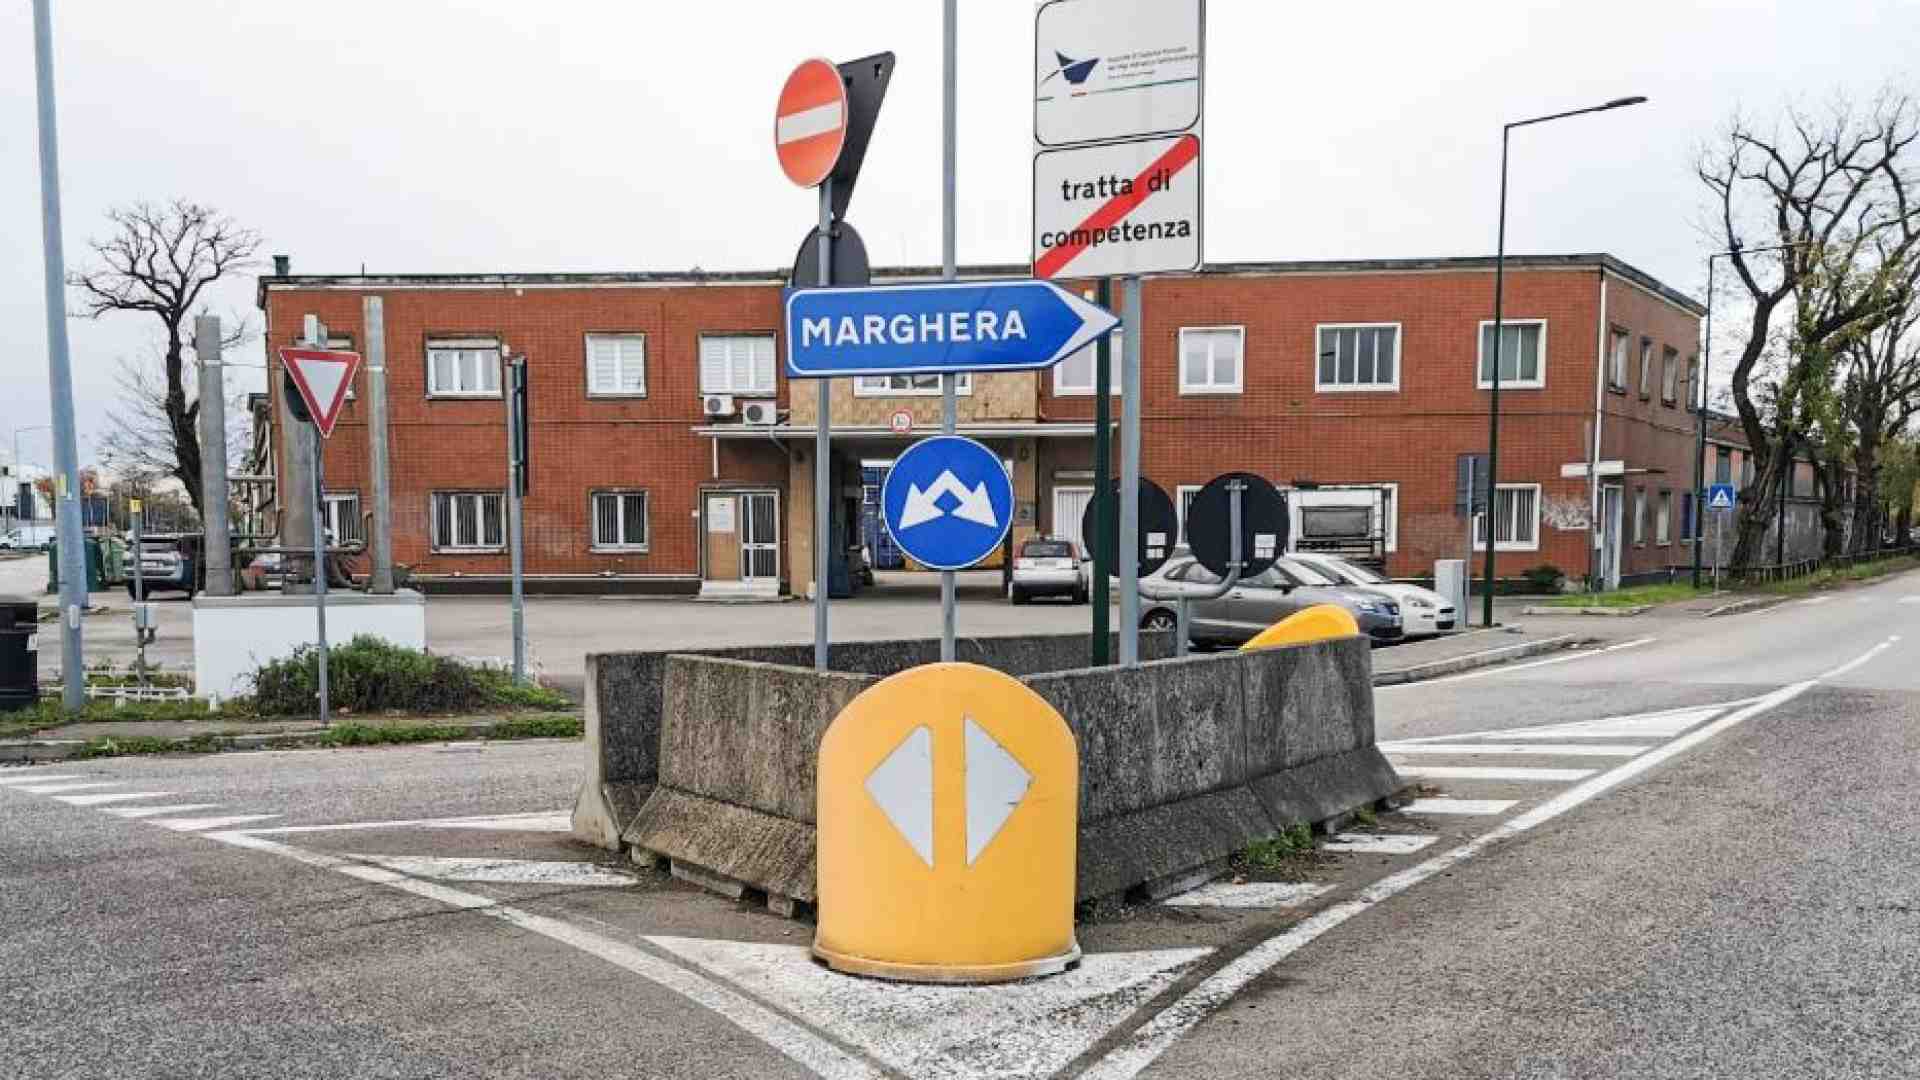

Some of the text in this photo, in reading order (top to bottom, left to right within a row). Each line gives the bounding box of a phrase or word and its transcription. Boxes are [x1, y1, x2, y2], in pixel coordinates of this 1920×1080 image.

[1062, 168, 1171, 200] tratta di
[1041, 219, 1191, 248] competenza
[801, 309, 1028, 348] MARGHERA
